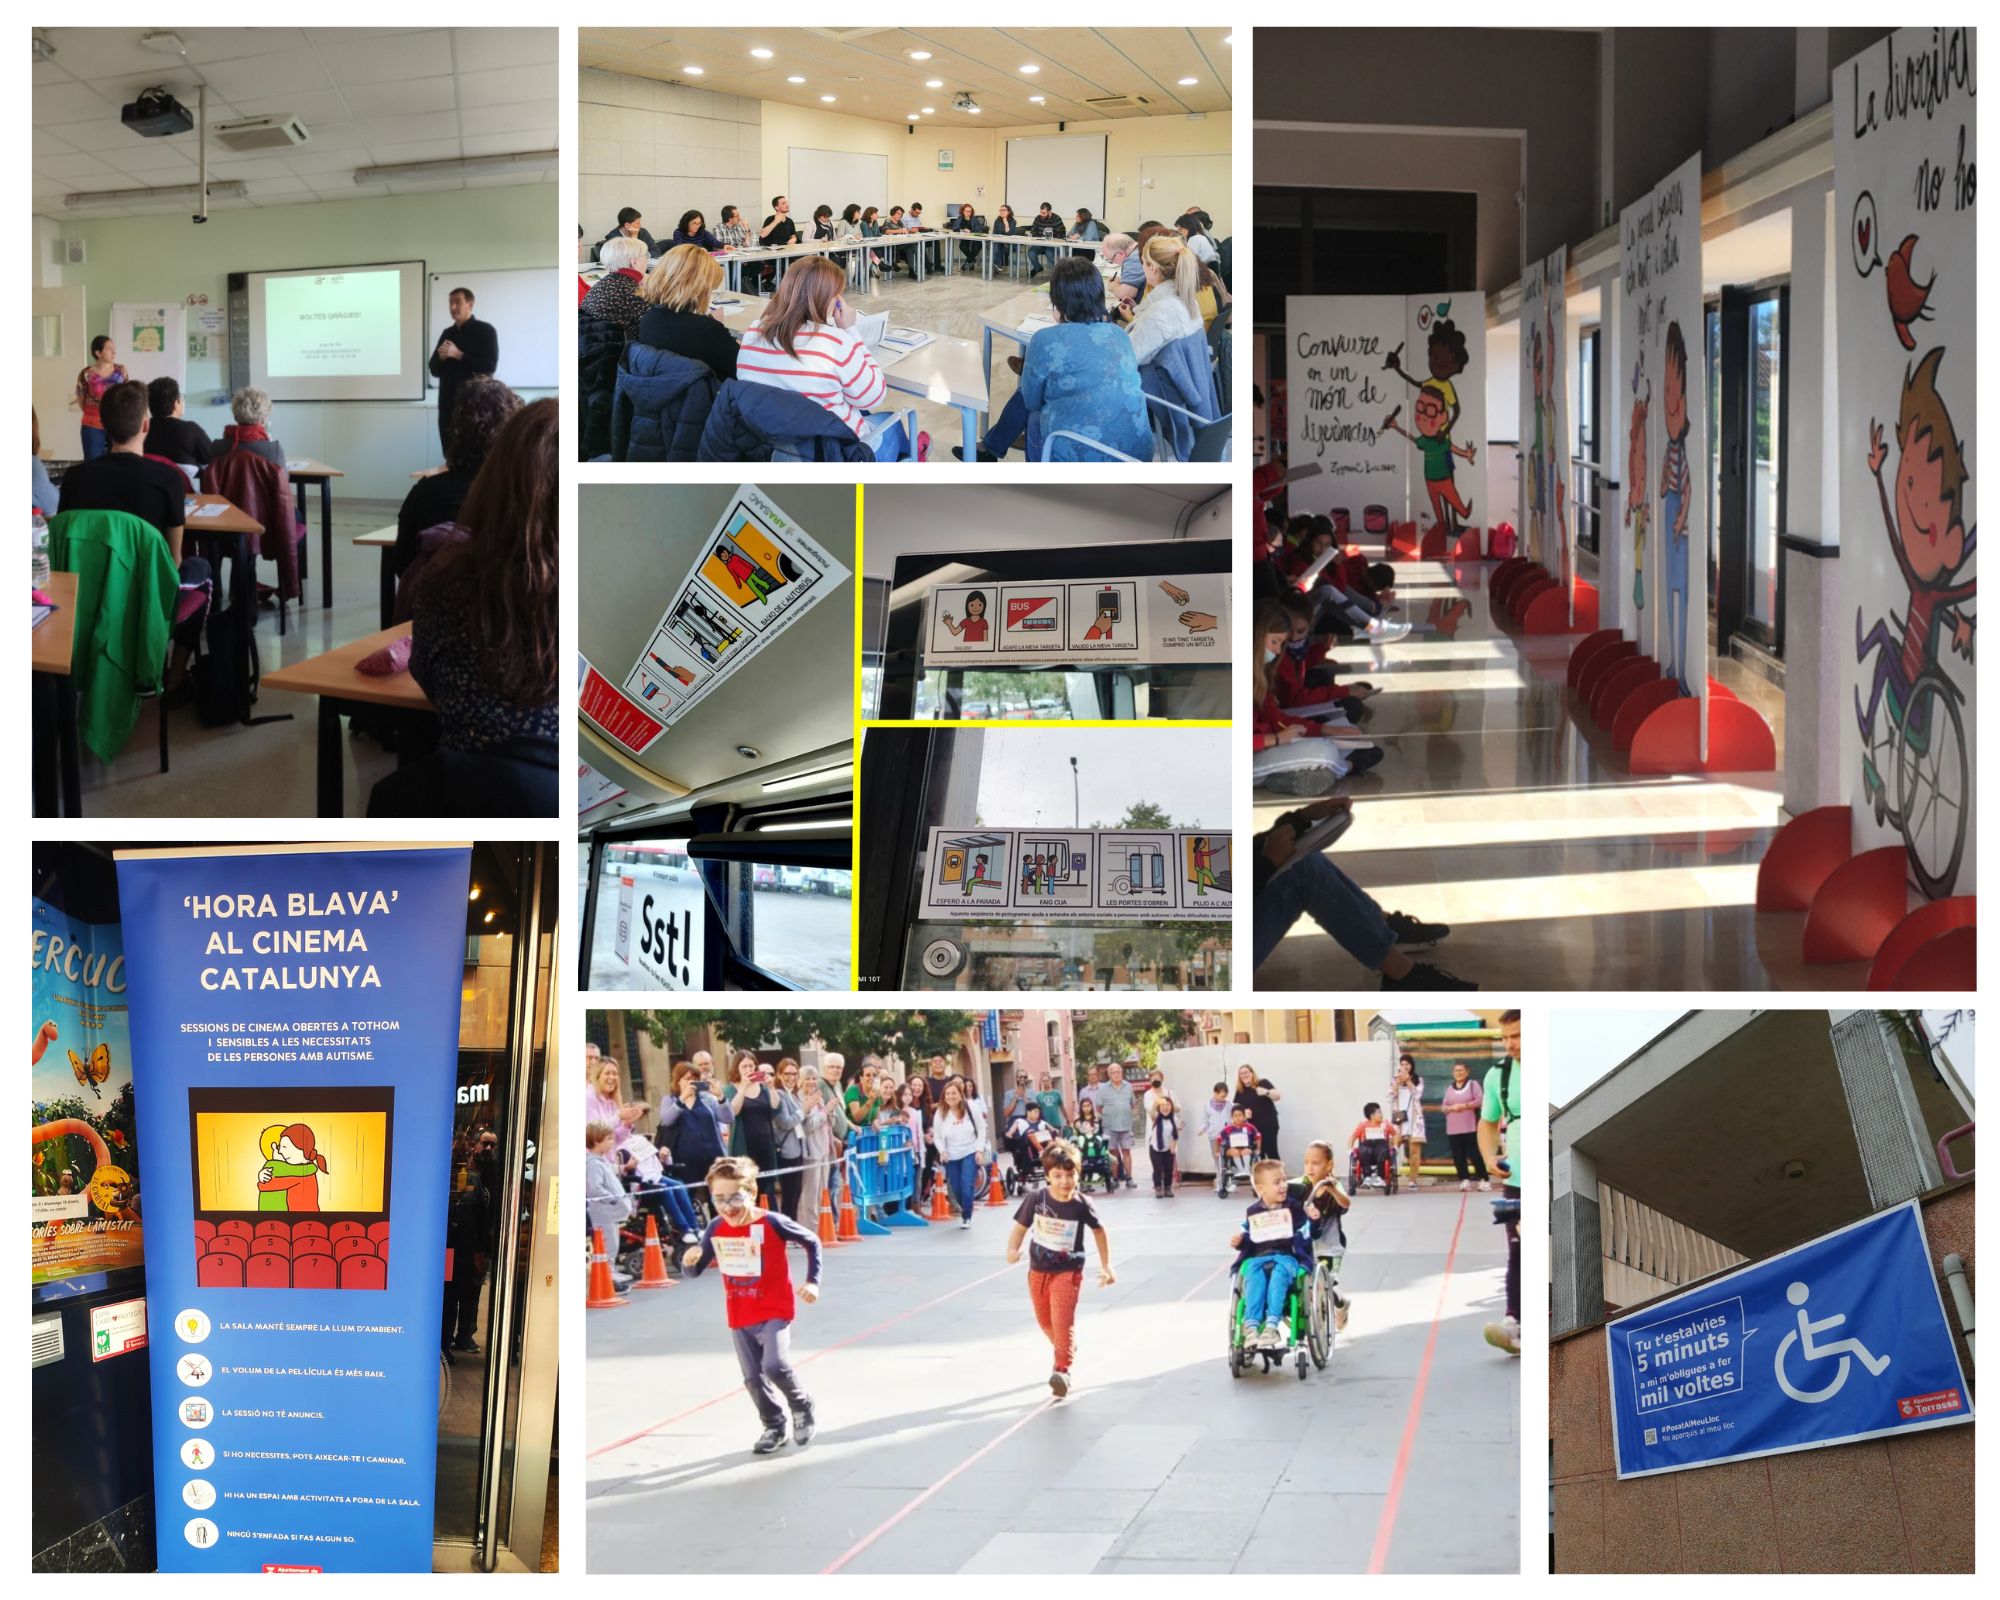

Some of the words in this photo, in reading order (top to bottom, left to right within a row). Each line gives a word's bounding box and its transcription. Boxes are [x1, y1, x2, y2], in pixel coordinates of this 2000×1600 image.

[1855, 62, 1878, 139] La
[1914, 158, 1945, 212] no
[1307, 367, 1323, 382] en
[1330, 366, 1357, 383] un
[1306, 386, 1352, 411] món
[1358, 376, 1387, 404] de
[749, 492, 786, 528] ARASAAC
[760, 609, 777, 626] BAIXO
[787, 577, 813, 604] AUTOBÚS
[1010, 602, 1030, 612] BUS
[205, 931, 244, 955] AL
[252, 928, 368, 954] CINEMA
[641, 894, 691, 986] Sst!
[200, 965, 382, 991] CATALUNYA
[180, 1023, 229, 1033] SESSIONS
[232, 1023, 245, 1032] DE
[249, 1023, 289, 1032] CINEMA
[292, 1022, 338, 1032] OBERTES
[341, 1022, 349, 1031] A
[352, 1021, 400, 1031] TOTHOM
[216, 1038, 269, 1047] SENSIBLES
[272, 1037, 280, 1047] A
[282, 1037, 300, 1047] LES
[302, 1036, 371, 1046] NECESSITATS
[208, 1053, 221, 1062] DE
[224, 1052, 241, 1062] LES
[244, 1052, 297, 1062] PERSONES
[300, 1052, 324, 1061] AMB
[326, 1051, 375, 1061] AUTISME.
[61, 1222, 85, 1235] SOBRE
[87, 1220, 135, 1232] L'AMISTAT
[224, 1238, 230, 1246] 3
[310, 1239, 315, 1247] 7
[217, 1258, 224, 1266] 3
[265, 1258, 272, 1267] 5
[312, 1259, 318, 1267] 7
[361, 1260, 367, 1268] 9
[255, 1322, 284, 1331] MANTÉ
[356, 1325, 405, 1334] D'AMBIENT.
[1635, 1341, 1652, 1352] Tu
[1655, 1315, 1727, 1347] t'estalvies
[1637, 1354, 1649, 1373] 5
[1654, 1332, 1730, 1367] minuts
[335, 1368, 344, 1377] ÉS
[346, 1368, 363, 1377] MÉS
[365, 1370, 386, 1378] BAIX.
[1647, 1377, 1658, 1387] mi
[1659, 1364, 1707, 1384] m'obligues
[1718, 1357, 1732, 1367] fer
[1641, 1385, 1669, 1408] mil
[1674, 1371, 1735, 1399] voltes
[234, 1409, 260, 1417] SESSIÓ
[276, 1409, 286, 1418] TÉ
[288, 1411, 325, 1419] ANUNCIS.
[1915, 1400, 1958, 1414] Terrassa
[1672, 1429, 1698, 1441] aparquis
[1707, 1425, 1722, 1433] meu
[1723, 1422, 1735, 1430] lloc
[315, 1454, 361, 1462] AIXECAR-TE
[367, 1456, 407, 1465] CAMINAR.
[281, 1493, 298, 1501] AMB
[300, 1494, 344, 1503] ACTIVITATS
[399, 1499, 421, 1507] SALA.
[227, 1530, 251, 1538] NINGÚ
[252, 1532, 289, 1541] S'ENFADA
[315, 1535, 342, 1543] ALGUN
